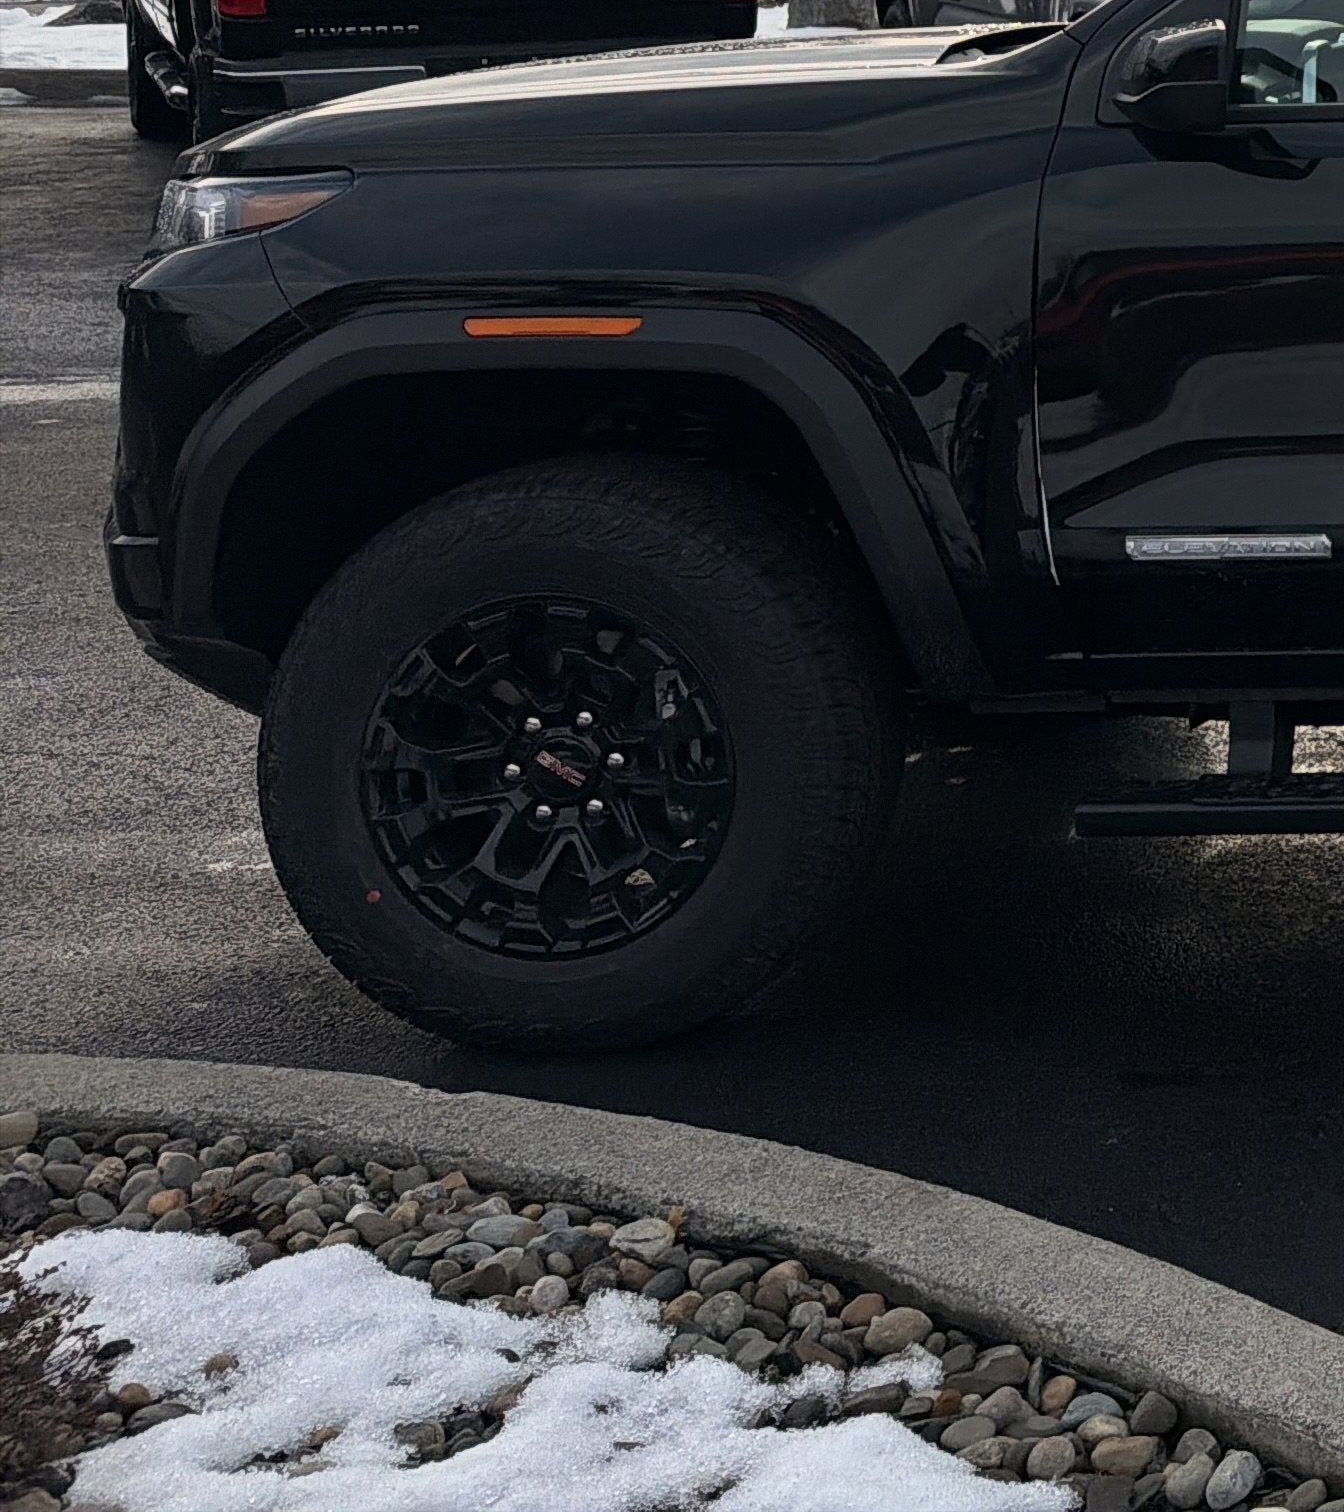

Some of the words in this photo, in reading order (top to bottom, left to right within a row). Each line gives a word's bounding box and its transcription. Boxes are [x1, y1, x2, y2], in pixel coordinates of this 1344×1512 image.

[294, 25, 419, 37] SILVERADO
[1141, 540, 1316, 555] ELEVATION
[536, 750, 586, 787] GMC
